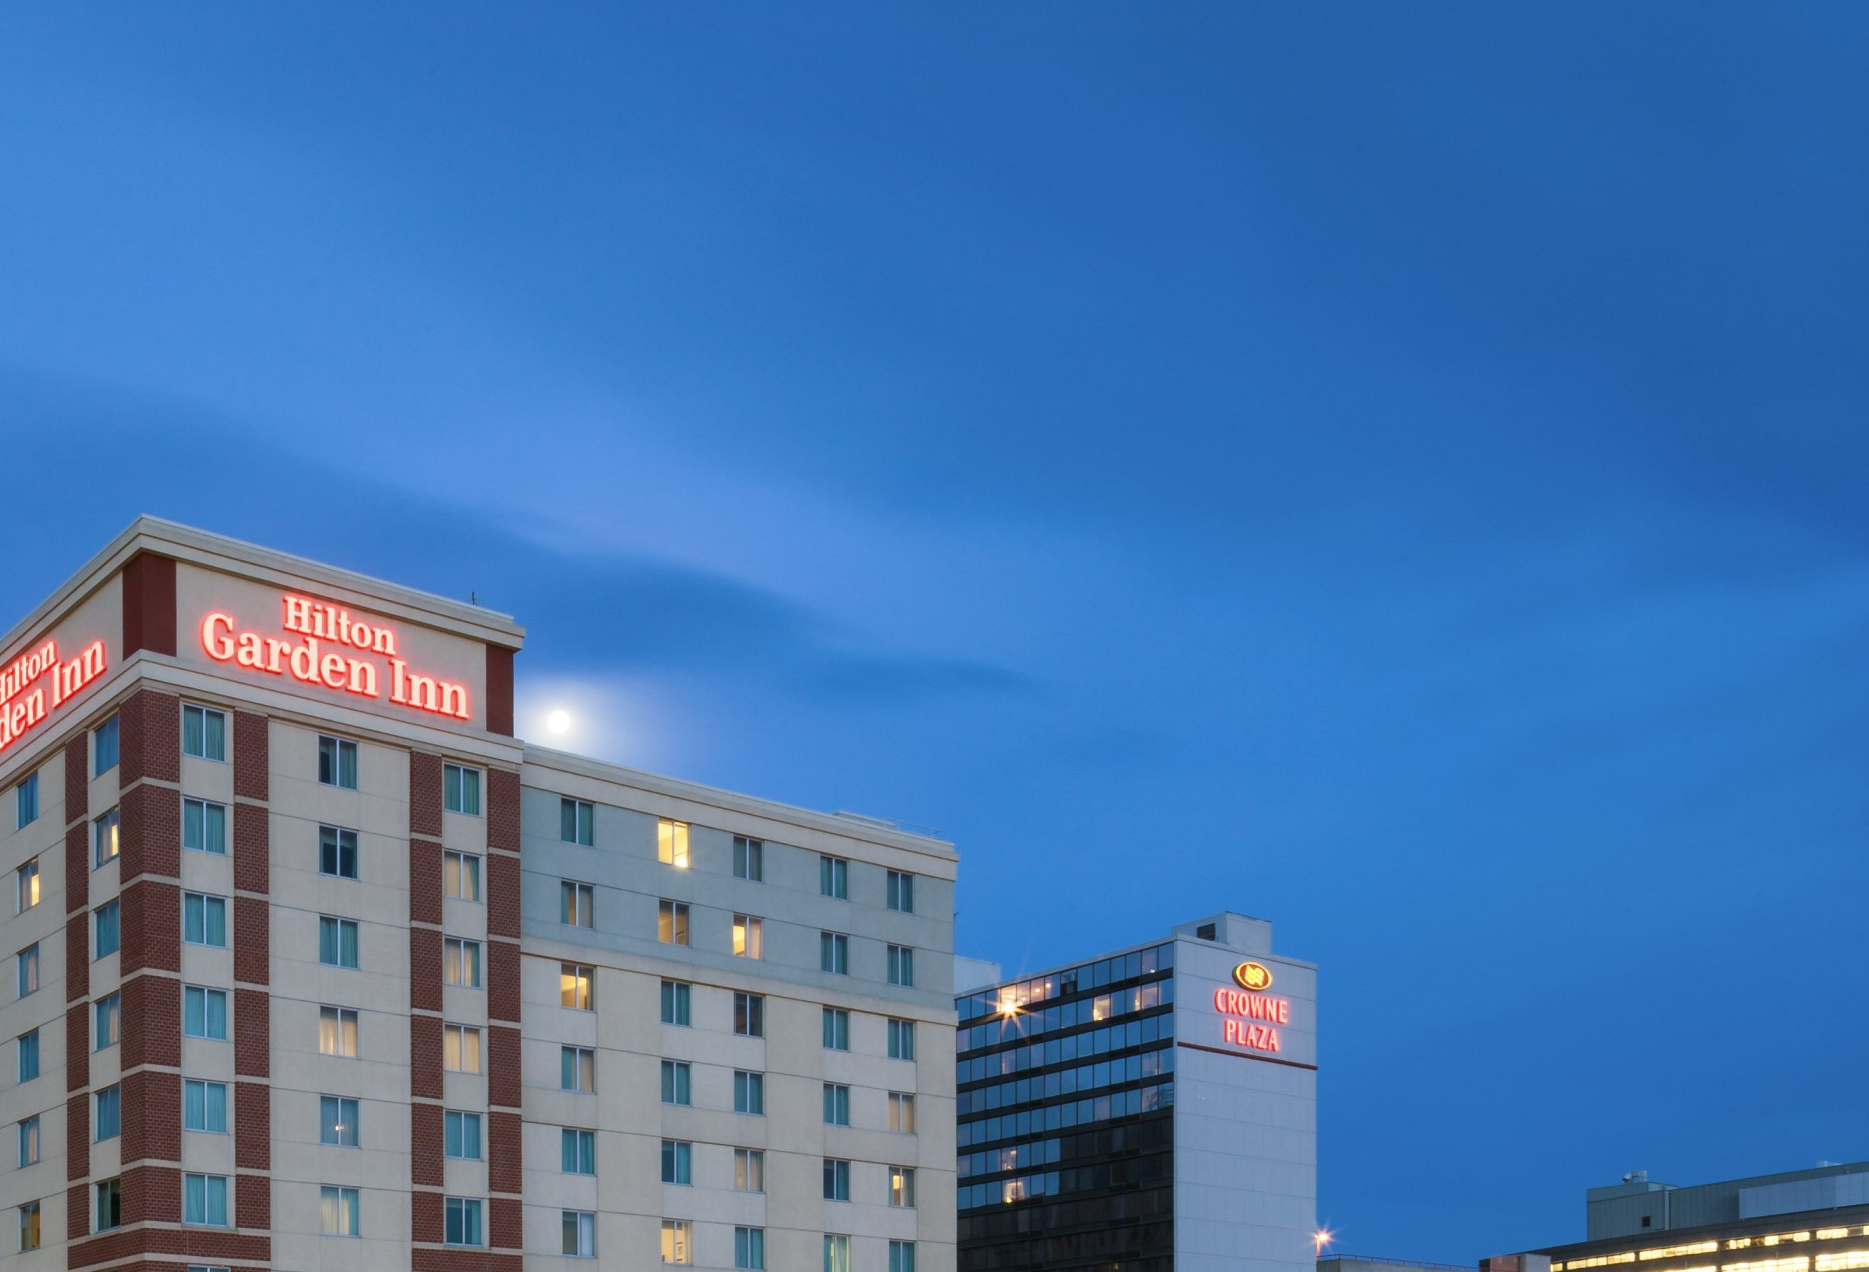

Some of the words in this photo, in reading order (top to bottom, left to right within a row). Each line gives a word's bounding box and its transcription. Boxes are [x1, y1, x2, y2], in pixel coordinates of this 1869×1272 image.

[283, 596, 396, 655] Hilton
[52, 641, 106, 708] Inn
[202, 613, 379, 698] Garden
[389, 658, 469, 719] Inn
[1215, 988, 1288, 1024] CROWNE
[1224, 1019, 1280, 1052] PLAZA
